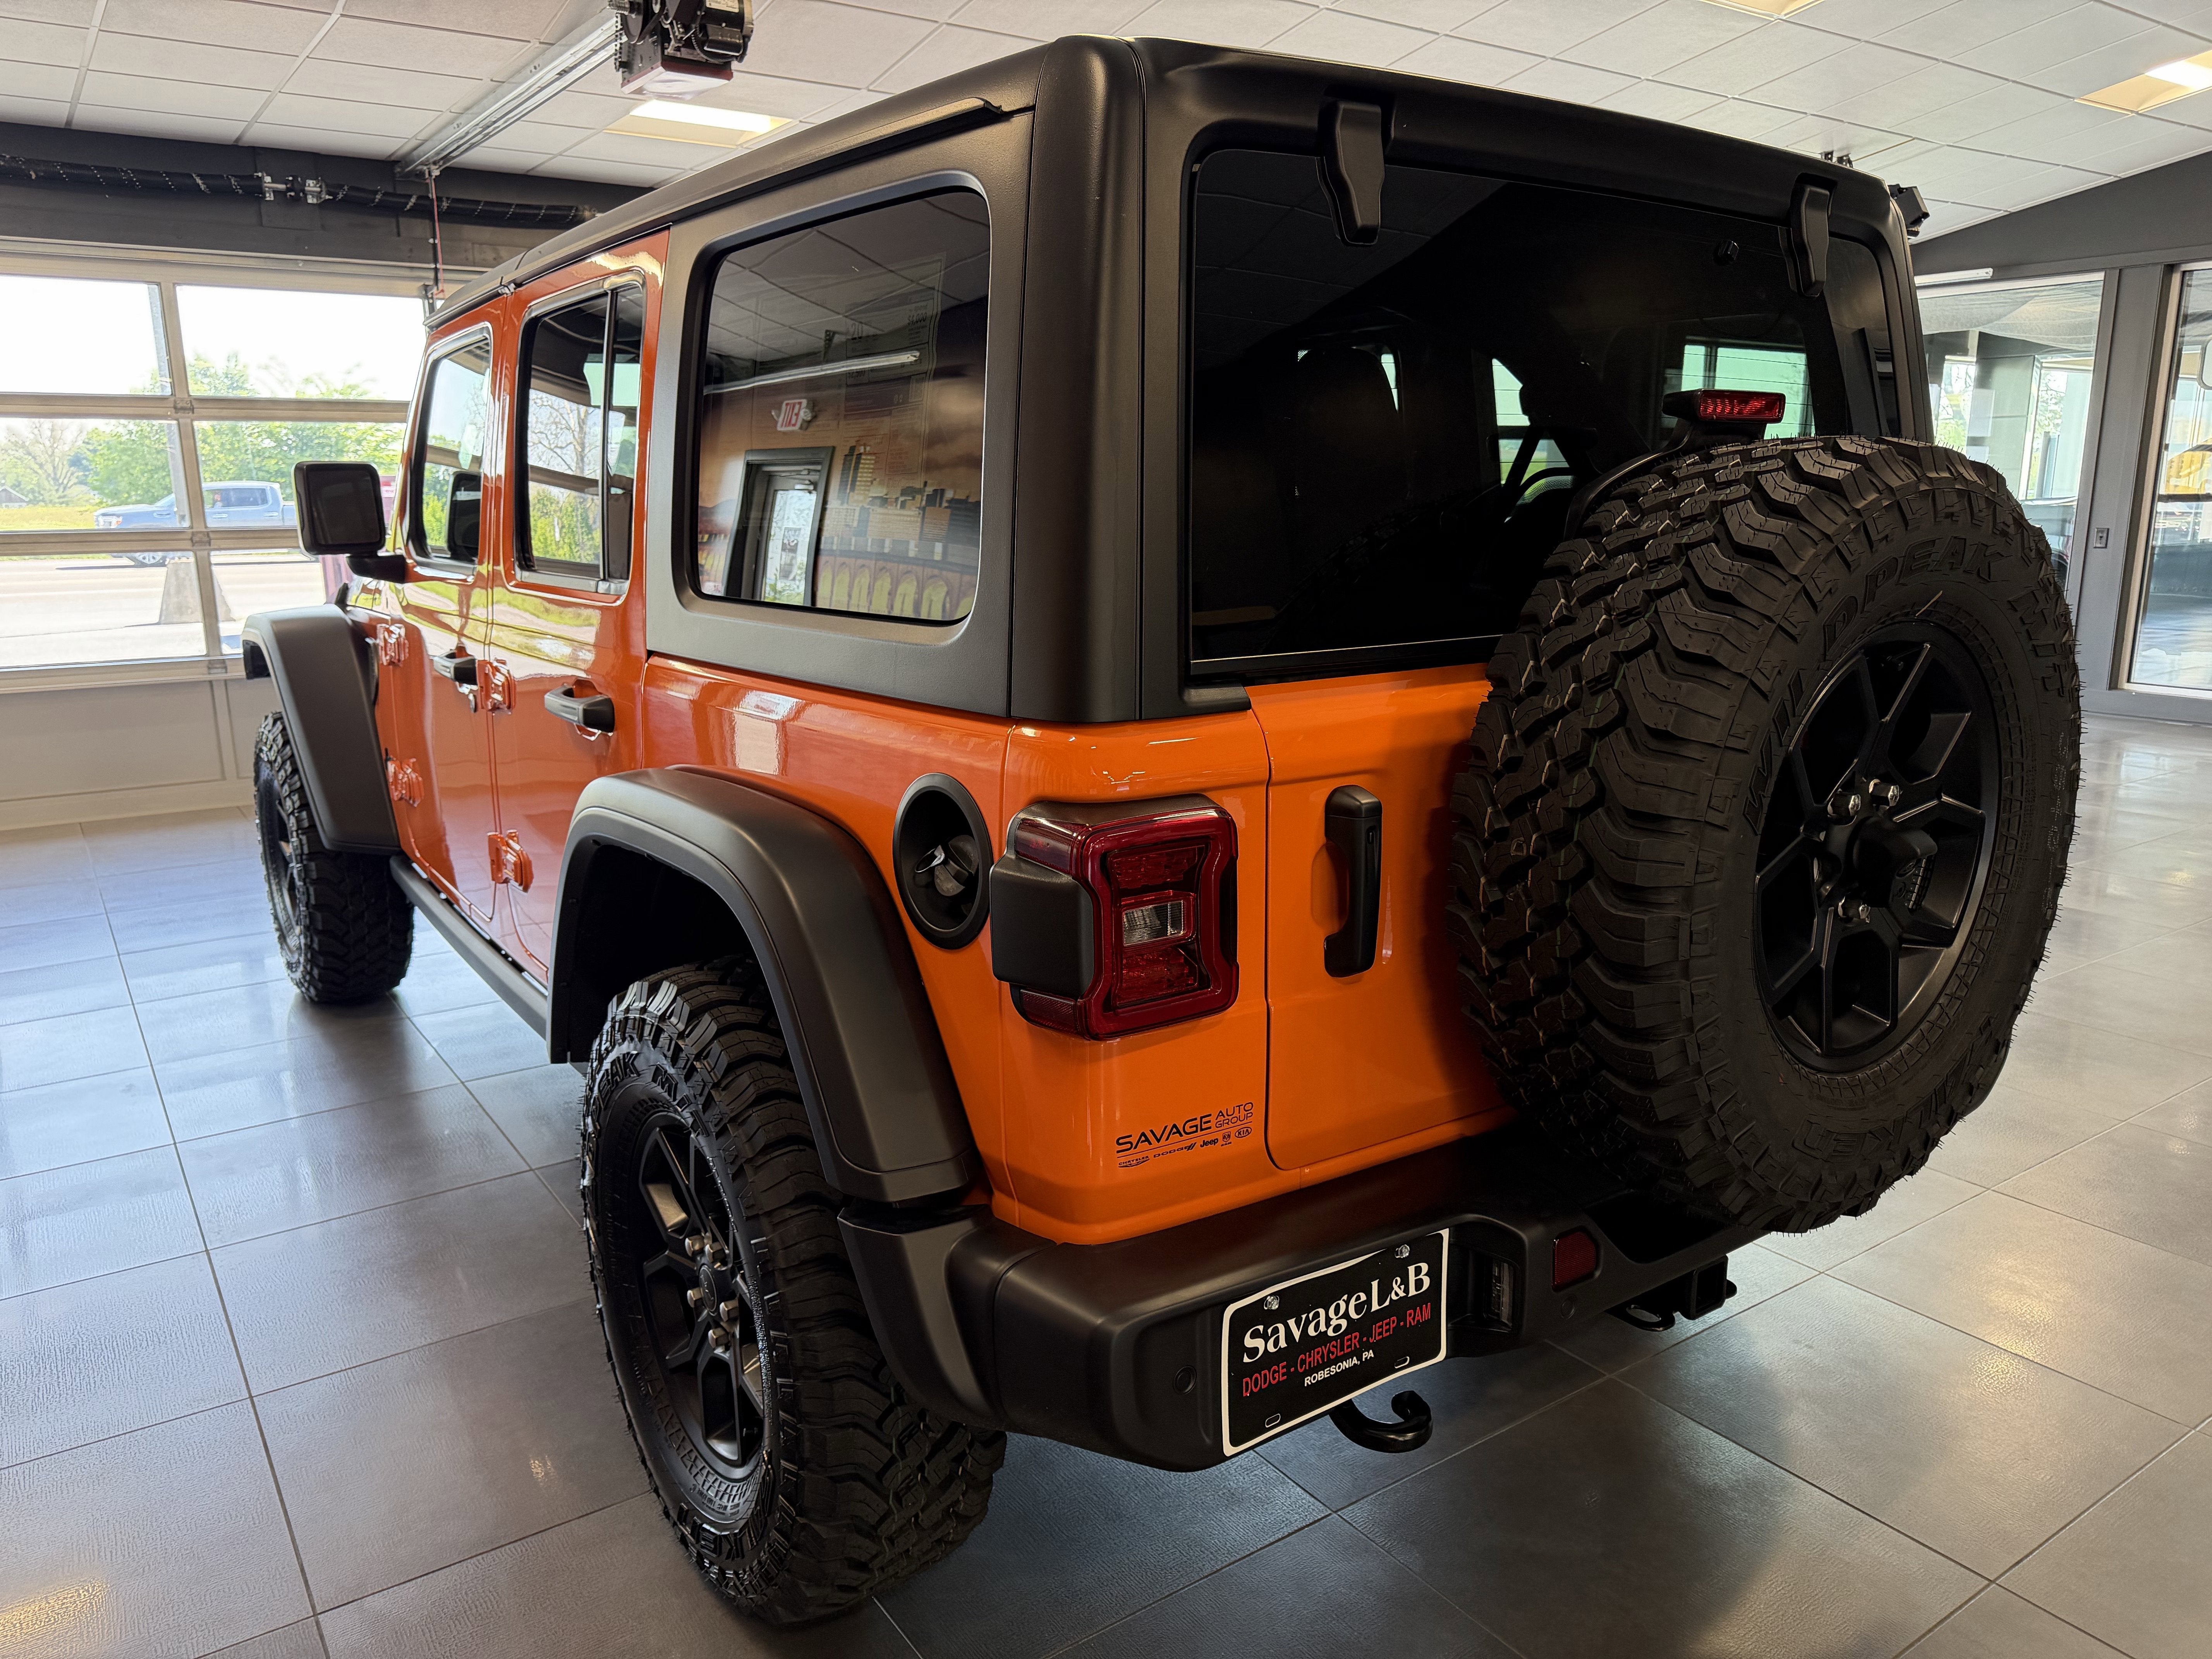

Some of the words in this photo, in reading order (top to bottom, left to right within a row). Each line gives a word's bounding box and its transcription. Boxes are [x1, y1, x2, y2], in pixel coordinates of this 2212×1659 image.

[1214, 1112, 1254, 1128] GROUP
[1215, 1102, 1254, 1120] AUTO
[1116, 1113, 1212, 1154] SAVAGE
[1200, 1137, 1219, 1148] Jeep
[1243, 1291, 1367, 1363] Savage
[1370, 1262, 1431, 1312] L&B
[1242, 1362, 1287, 1397] DODGE
[1297, 1332, 1360, 1373] CHRYSLER
[1369, 1316, 1397, 1343] JEEP
[1406, 1302, 1431, 1328] RAM
[1304, 1356, 1361, 1387] ROBESONIA,
[1362, 1349, 1374, 1362] PA
